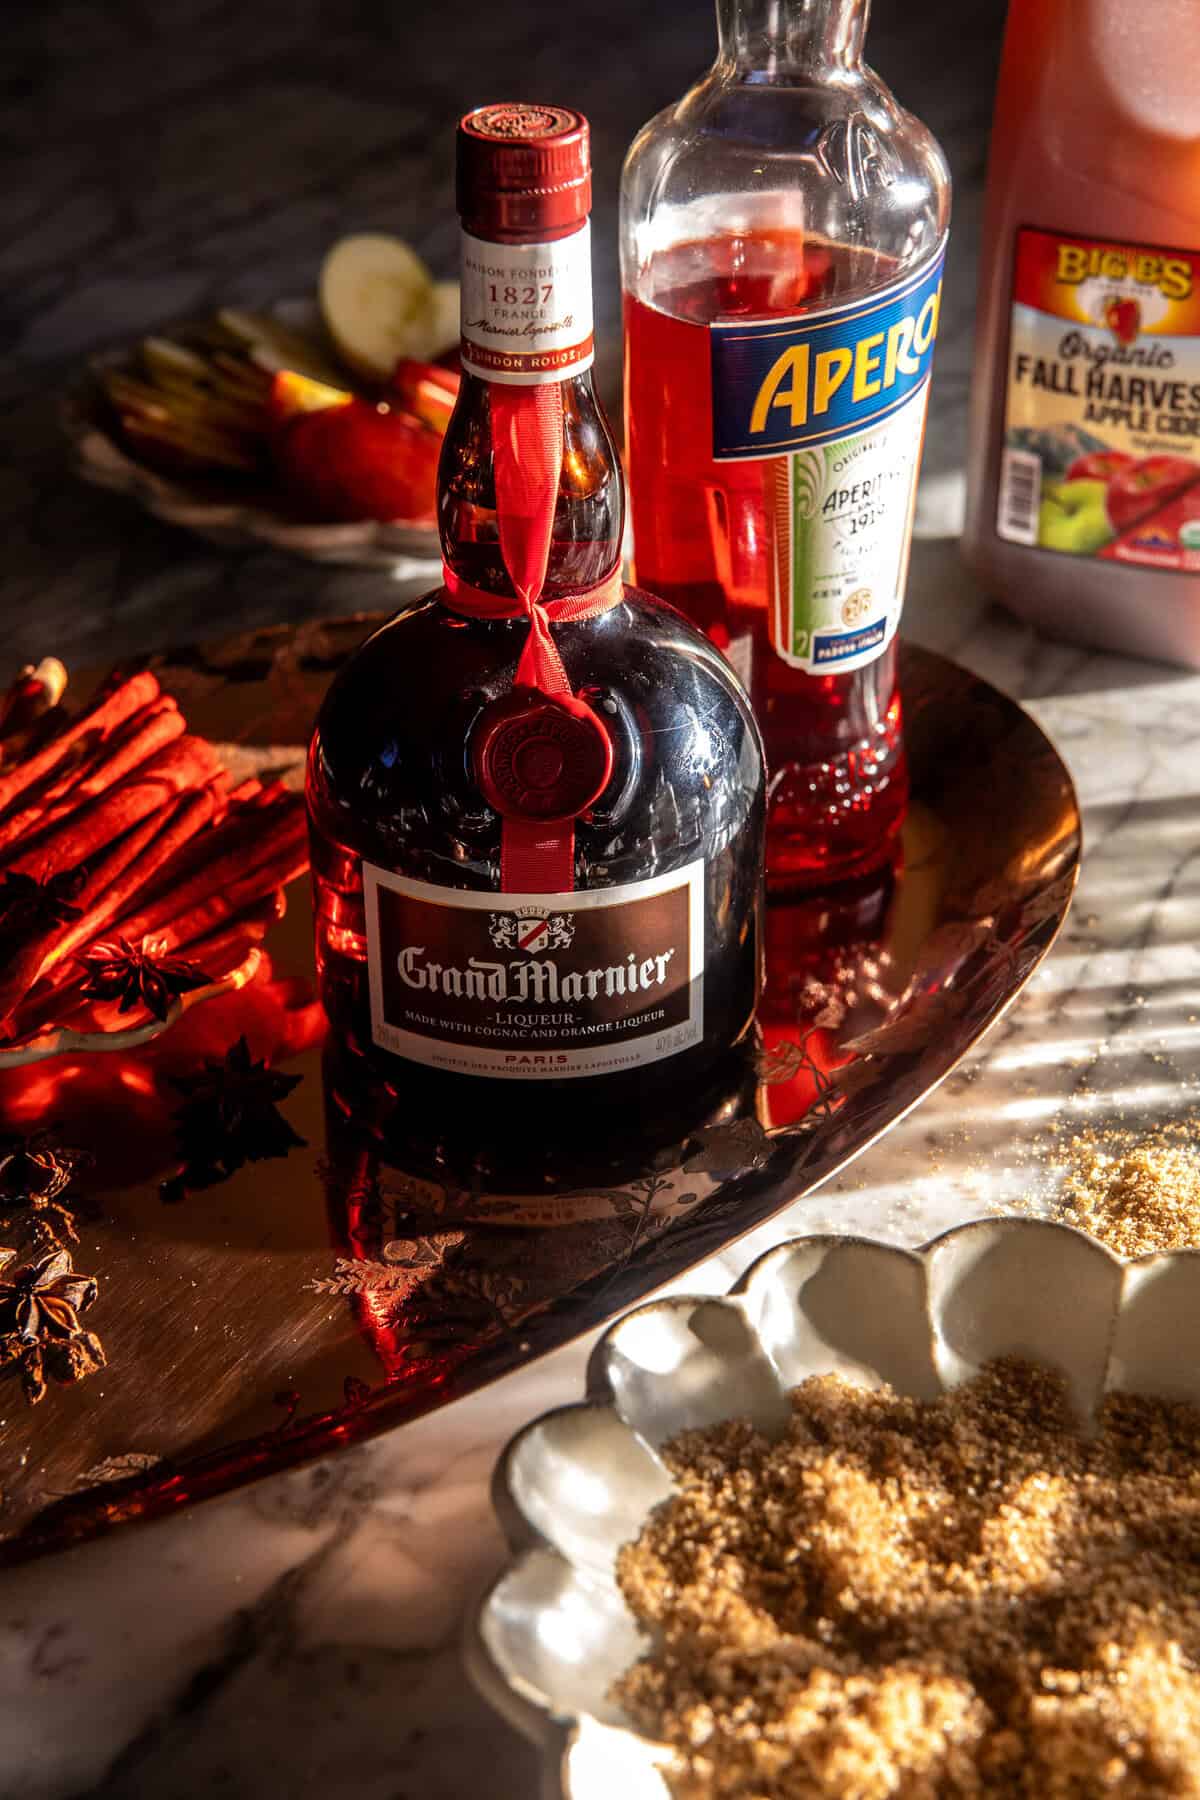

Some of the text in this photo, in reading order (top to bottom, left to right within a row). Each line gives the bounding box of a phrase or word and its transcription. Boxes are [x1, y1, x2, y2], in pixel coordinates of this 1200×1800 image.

[489, 284, 553, 305] 1827
[530, 349, 576, 368] ROUGE
[1058, 329, 1174, 370] Organic
[1015, 353, 1200, 412] FALL HARVES
[1083, 401, 1149, 432] APPLE
[397, 946, 676, 1004] Grand Marnier
[404, 1008, 666, 1039] MADE WITH COGNAC AND ORANGE LIQUEUR
[504, 1054, 569, 1065] PARIS
